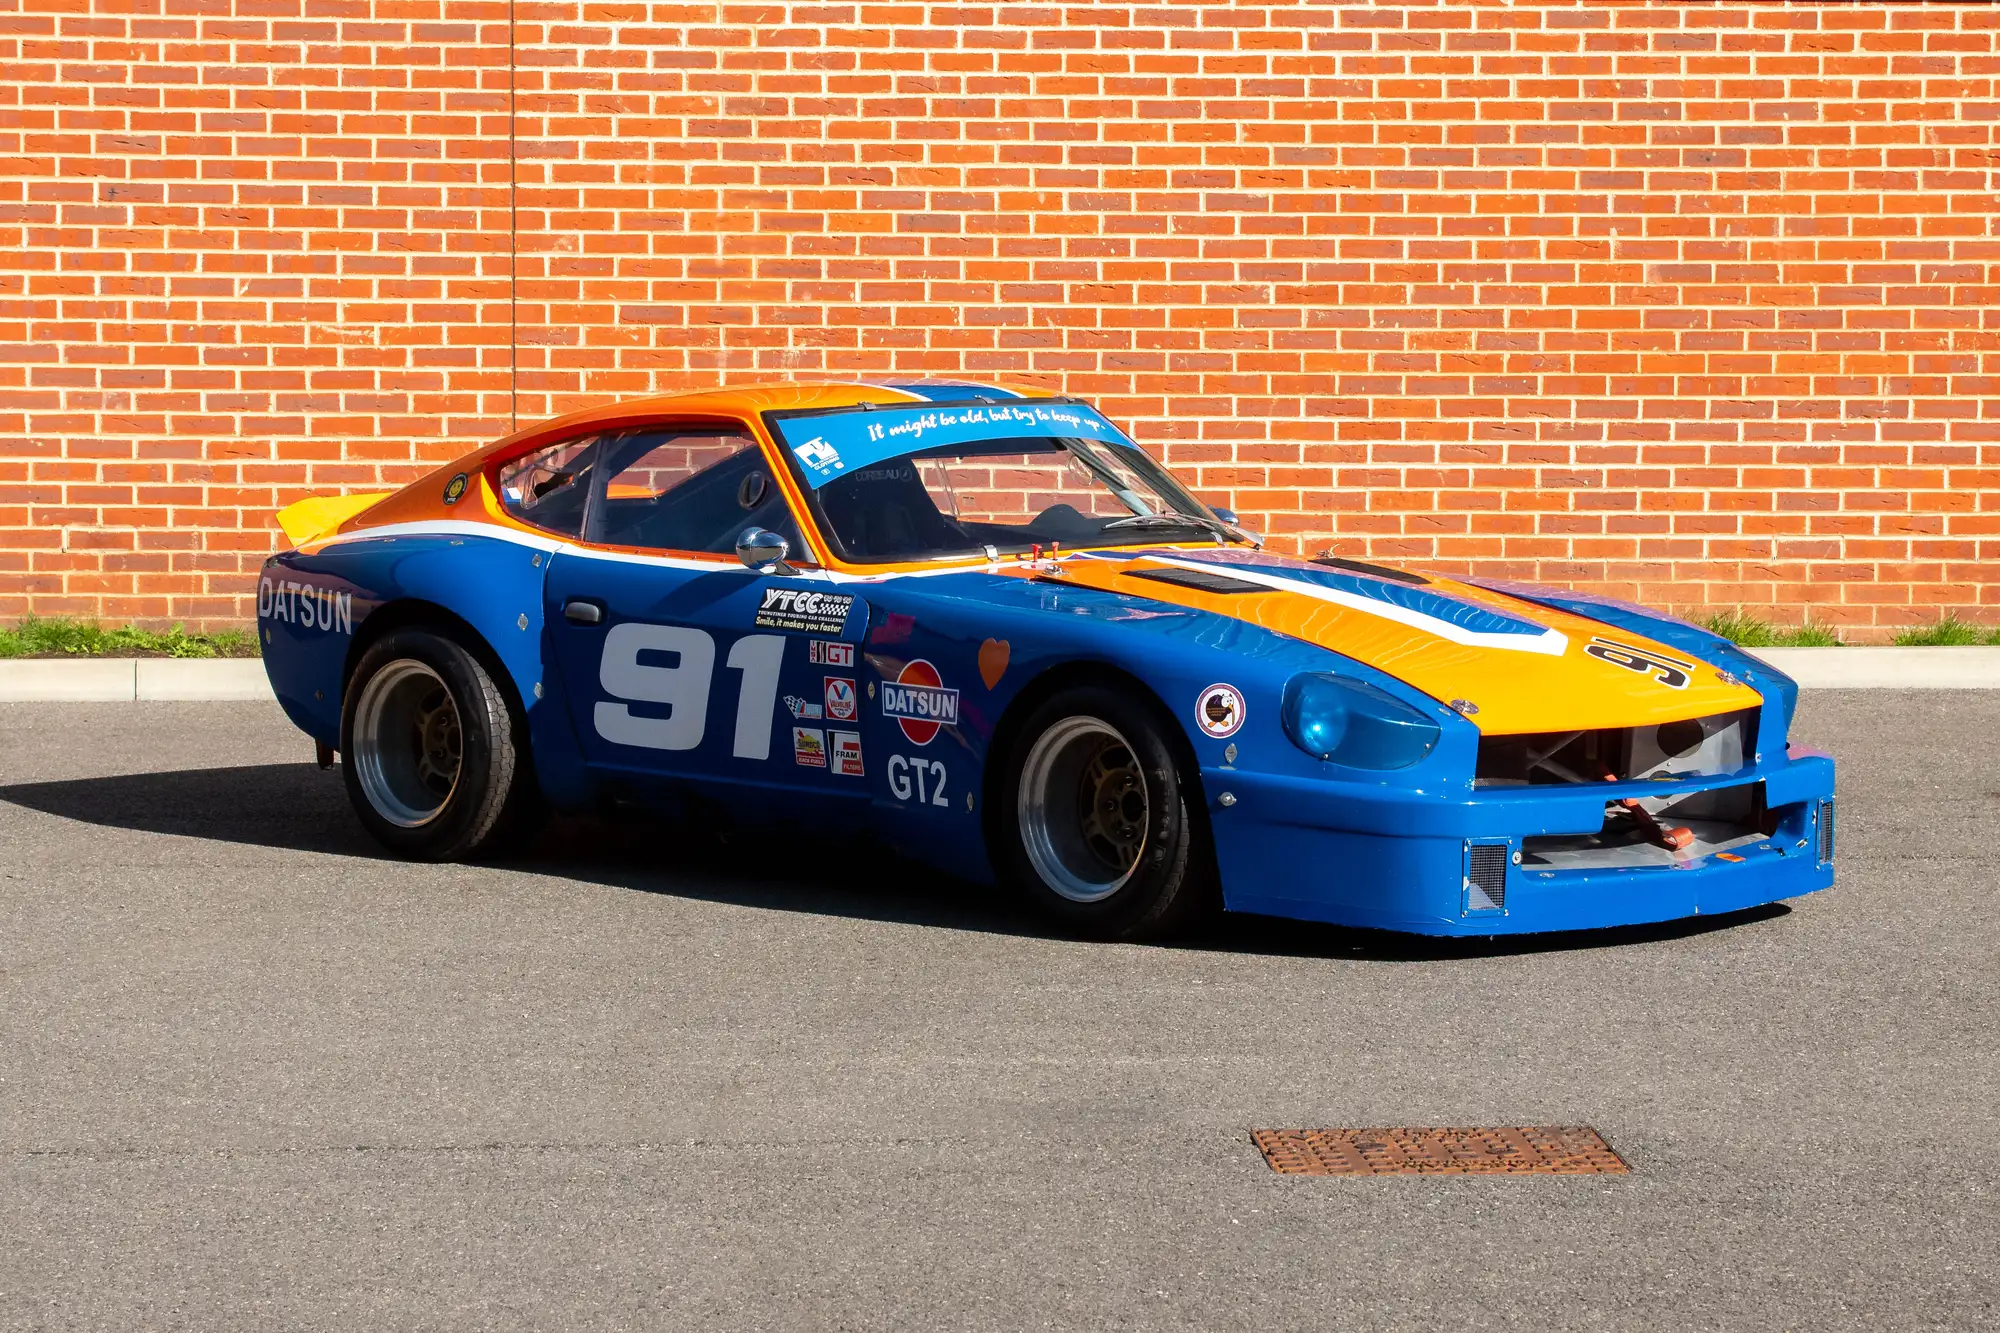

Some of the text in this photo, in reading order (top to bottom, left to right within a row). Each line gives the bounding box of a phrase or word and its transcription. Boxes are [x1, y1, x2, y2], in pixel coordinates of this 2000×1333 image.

[867, 407, 1106, 442] It might be old, but try to keep up.
[259, 576, 351, 635] DATSUN
[761, 588, 824, 614] YTCC
[756, 616, 841, 633] Smile, it makes you faster
[828, 644, 852, 664] GT
[593, 622, 786, 760] 91
[885, 687, 955, 718] DATSUN
[836, 750, 858, 759] FRAM
[887, 754, 948, 807] GT2
